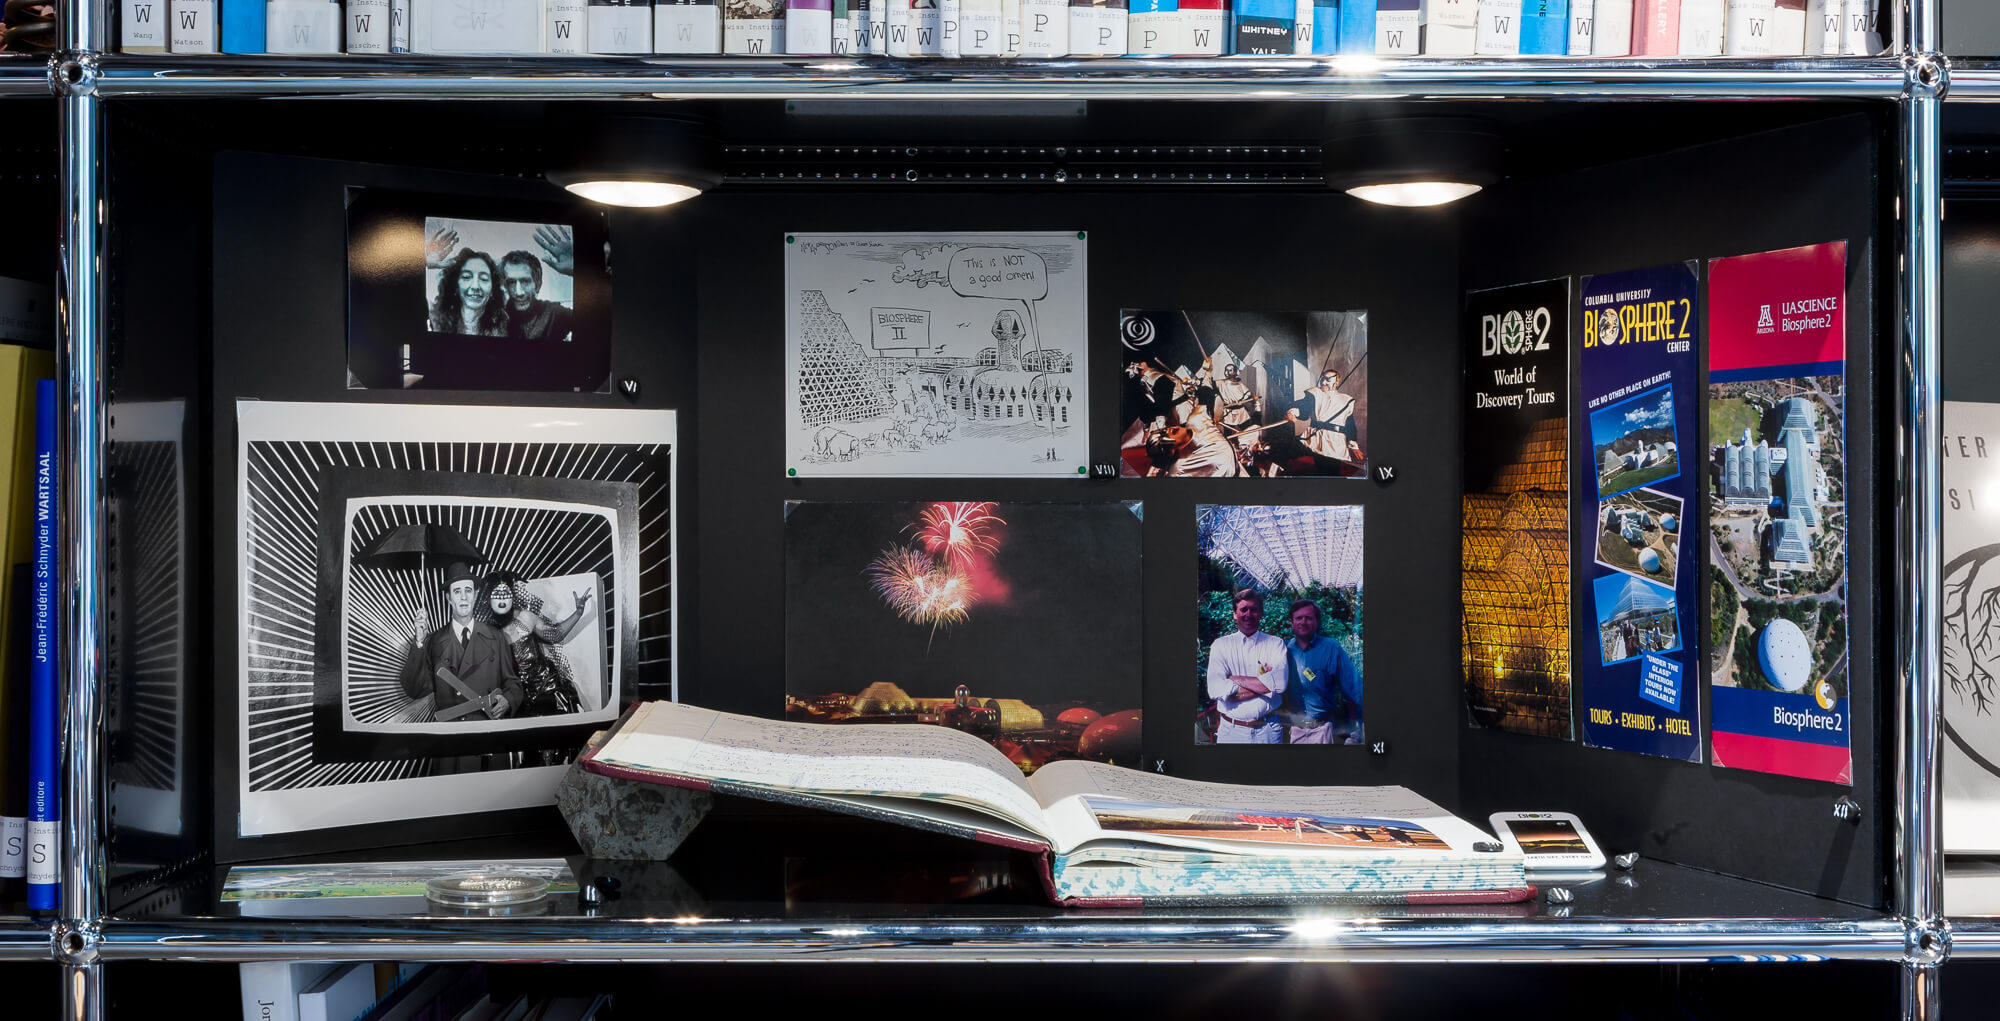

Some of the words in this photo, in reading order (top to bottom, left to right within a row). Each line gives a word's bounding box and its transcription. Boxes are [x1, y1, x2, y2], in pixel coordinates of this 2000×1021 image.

[134, 4, 152, 23] W
[179, 11, 198, 30] W
[1034, 13, 1049, 32] P
[1852, 14, 1868, 32] W
[354, 14, 372, 33] W
[554, 20, 572, 39] W
[869, 21, 887, 39] W
[944, 20, 957, 39] P
[1241, 25, 1288, 36] WHITNEY
[1296, 23, 1312, 42] W
[1494, 15, 1511, 35] W
[1576, 17, 1592, 36] W
[1749, 18, 1765, 37] W
[1823, 14, 1840, 33] W
[133, 31, 153, 42] Wang
[174, 38, 204, 47] Watson
[854, 29, 870, 47] W
[890, 24, 907, 43] W
[916, 27, 933, 46] W
[974, 29, 988, 48] P
[1007, 33, 1021, 52] P
[1098, 27, 1112, 46] P
[1143, 30, 1157, 49] P
[1193, 29, 1210, 48] W
[1386, 30, 1403, 49] W
[746, 38, 763, 54] W
[833, 38, 848, 54] W
[963, 257, 983, 269] This
[1003, 254, 1026, 267] NOT
[969, 275, 977, 285] a
[978, 270, 1002, 288] good
[1584, 293, 1614, 307] COLUMBIA
[1615, 288, 1652, 303] UNIVERSITY
[877, 312, 925, 325] BIOSPHERE
[1678, 297, 1691, 339] 2
[1533, 305, 1551, 351] 2
[1667, 340, 1690, 353] CENTER
[1494, 366, 1523, 387] World
[1525, 365, 1537, 384] of
[624, 380, 637, 393] VI
[1588, 397, 1600, 409] LIKE
[1600, 394, 1608, 405] NO
[1608, 387, 1626, 401] OTHER
[1625, 380, 1642, 395] PLACE
[1642, 378, 1652, 388] ON
[1651, 370, 1672, 385] EARTH!
[1476, 391, 1524, 410] Discovery
[1525, 387, 1556, 405] Tours
[1378, 466, 1394, 480] IX
[39, 450, 50, 521] WARTSAAL
[37, 524, 51, 580] Schnyder
[36, 582, 48, 664] Jean-Frédéric
[1644, 678, 1663, 692] TOURS
[1589, 707, 1612, 726] TOURS
[1621, 711, 1656, 731] EXHIBITS
[1665, 717, 1692, 737] HOTEL
[1373, 741, 1385, 754] XI
[1156, 759, 1165, 774] X
[36, 781, 45, 812] editore
[1833, 803, 1848, 819] XII
[6, 836, 22, 856] S
[32, 842, 46, 864] S
